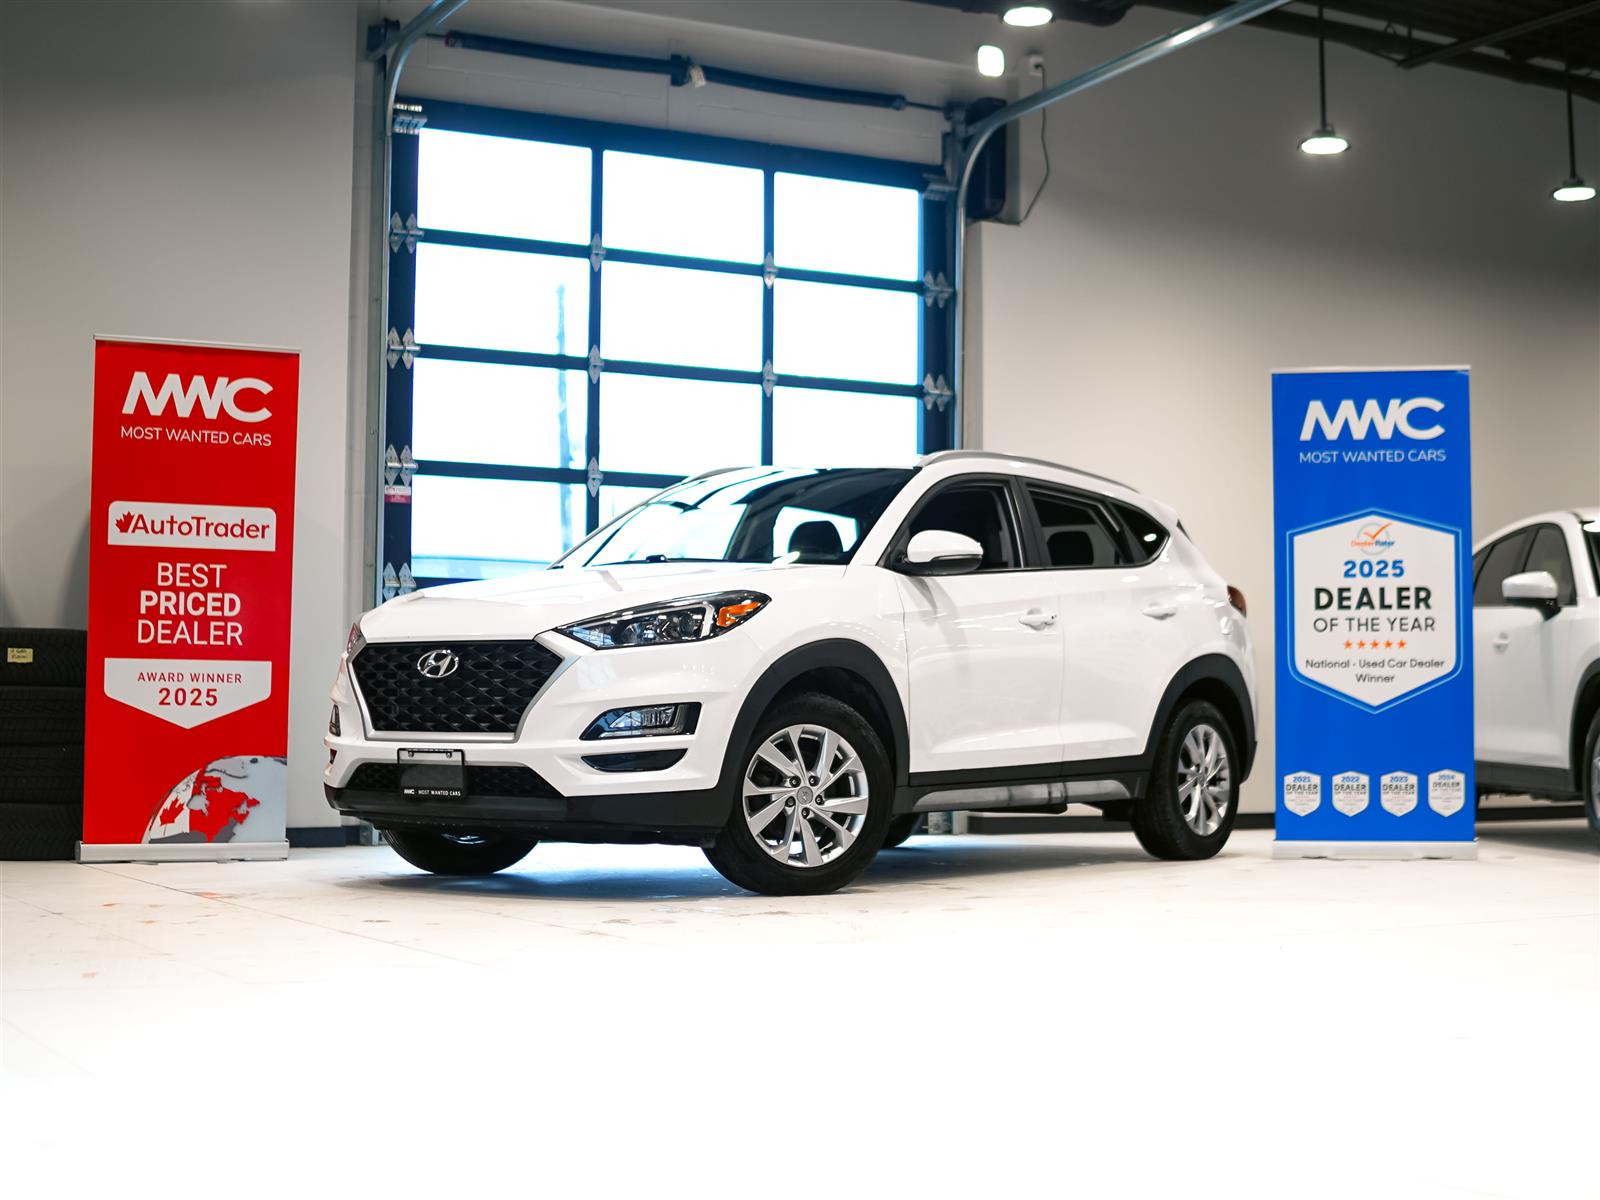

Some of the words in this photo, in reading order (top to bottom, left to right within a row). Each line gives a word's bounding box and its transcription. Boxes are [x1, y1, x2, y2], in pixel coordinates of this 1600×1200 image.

[121, 371, 274, 423] MWC
[1300, 397, 1446, 441] MWC
[121, 425, 162, 441] MOST
[166, 428, 229, 445] WANTED
[232, 432, 272, 447] CARS
[1299, 450, 1339, 464] MOST
[1342, 449, 1405, 463] WANTED
[1407, 448, 1447, 462] CARS
[131, 513, 270, 540] AutoTrader
[157, 561, 228, 589] BEST
[1343, 559, 1405, 579] 2025
[139, 589, 242, 617] PRICED
[1314, 586, 1432, 611] DEALER
[137, 618, 243, 646] DEALER
[1313, 617, 1338, 633] OF
[1345, 617, 1380, 632] THE
[1387, 616, 1435, 632] YEAR
[1305, 658, 1350, 669] National
[1358, 658, 1385, 669] Used
[1387, 657, 1407, 669] Car
[1409, 656, 1445, 668] Dealer
[137, 671, 185, 683] AWARD
[190, 672, 242, 684] WINNER
[1355, 673, 1396, 684] Winner
[158, 687, 218, 707] 2025
